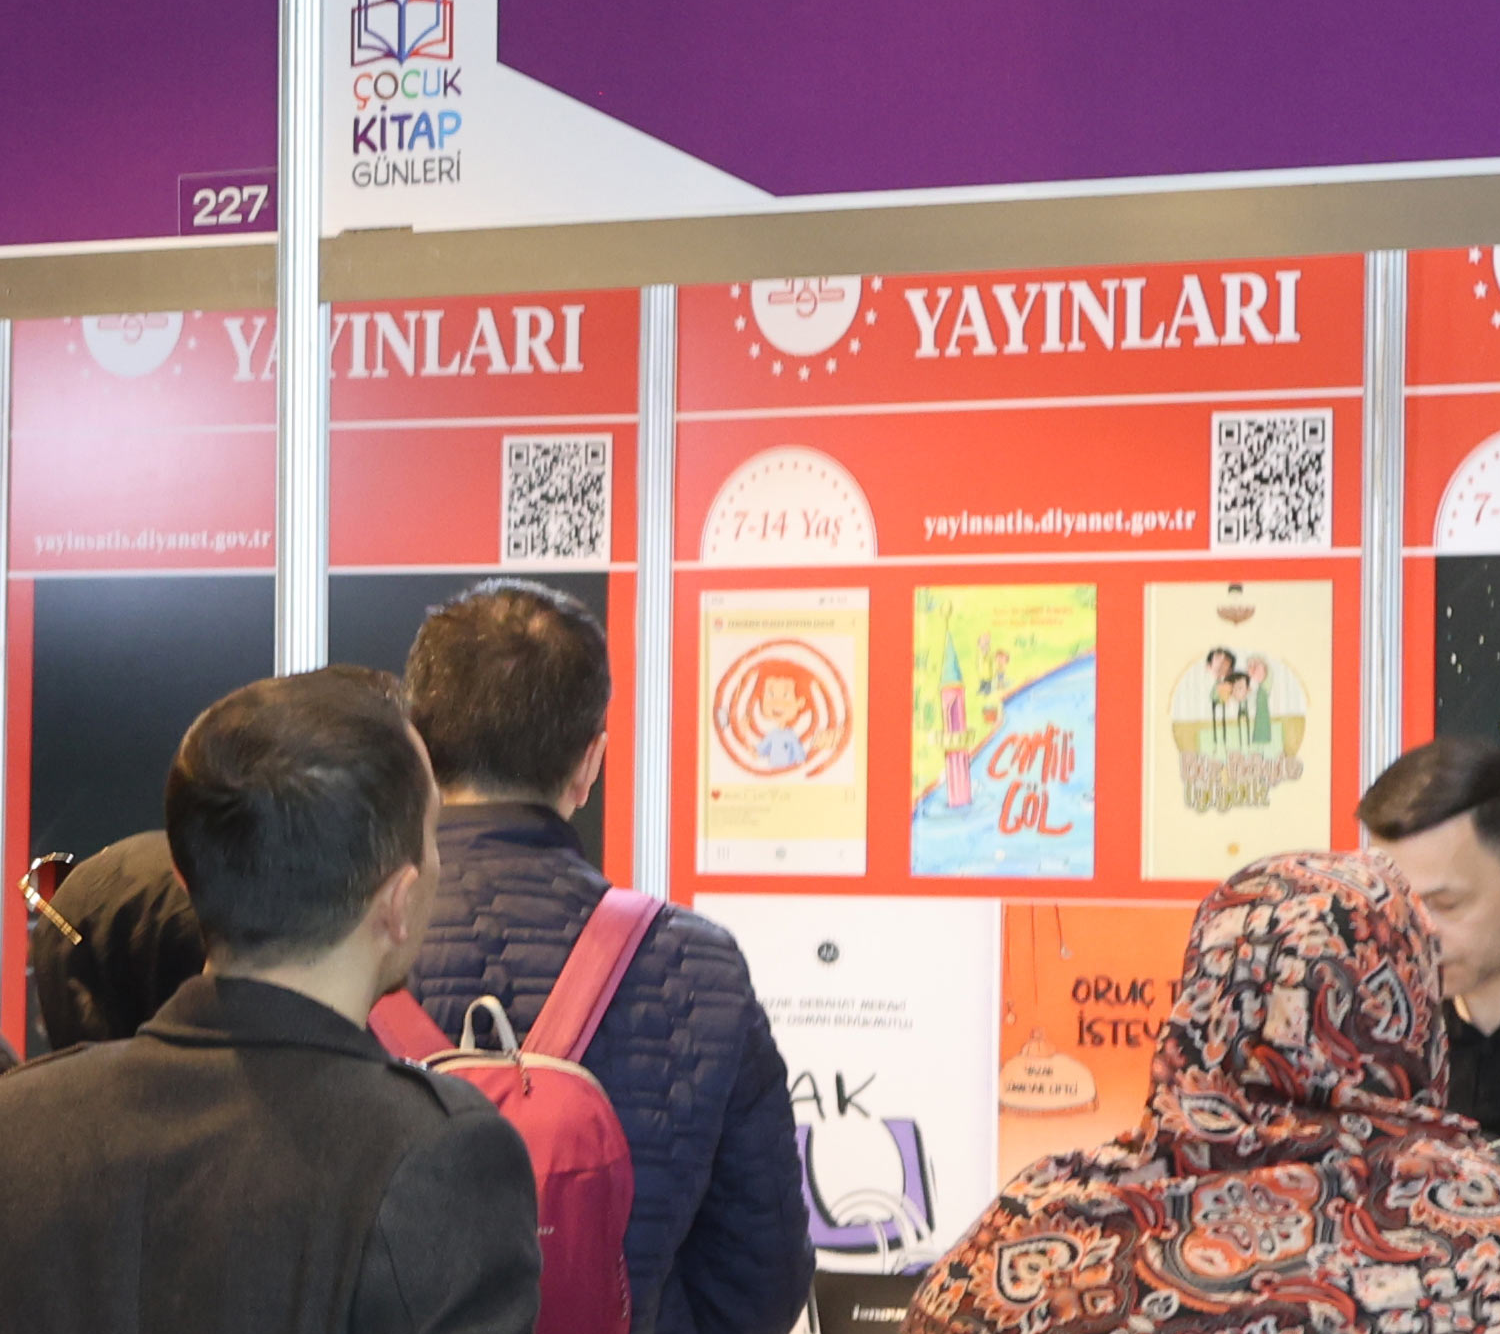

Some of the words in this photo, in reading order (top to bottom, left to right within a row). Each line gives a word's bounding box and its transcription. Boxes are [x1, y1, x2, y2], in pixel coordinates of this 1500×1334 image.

[353, 68, 462, 109] ÇOCUK
[353, 104, 462, 156] KİTAP
[352, 151, 461, 188] GÜNLERİ
[192, 184, 268, 225] 227
[904, 270, 1302, 358] YAYINLARI
[733, 509, 789, 541] 7-14
[800, 505, 843, 547] Yaş
[923, 507, 1197, 540] yayinsatis.diyanet.gov.tr
